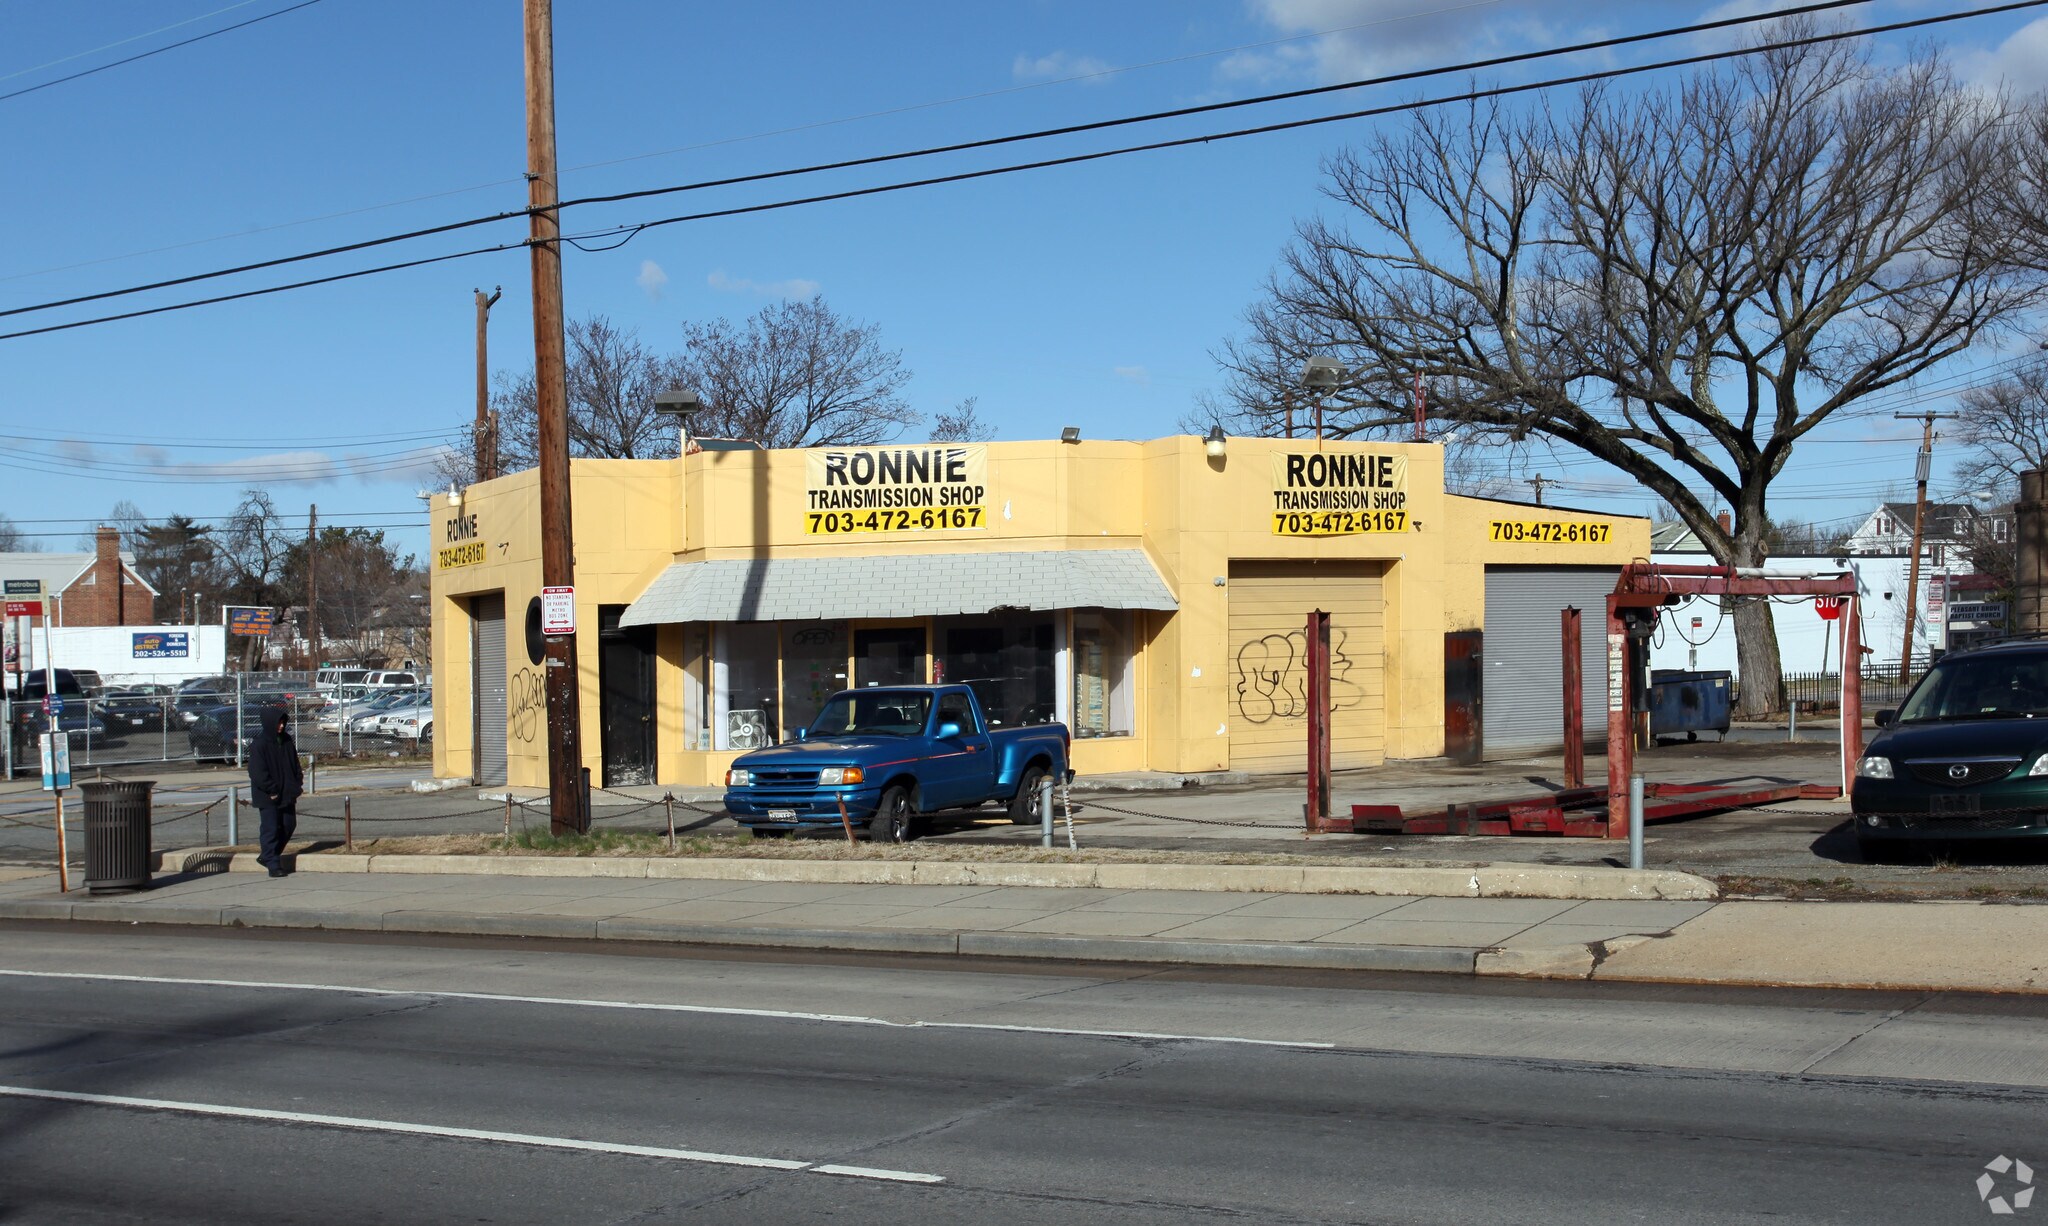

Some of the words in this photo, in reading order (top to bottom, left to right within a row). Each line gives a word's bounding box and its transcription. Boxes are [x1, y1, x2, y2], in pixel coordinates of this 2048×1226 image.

[826, 449, 966, 486] RONNIE
[1287, 454, 1393, 488] RONNIE
[808, 486, 933, 509] TRANSMISSION
[939, 485, 984, 506] SHOP
[1274, 490, 1369, 510] TRANSMISSION
[1373, 491, 1406, 510] SHOP
[447, 514, 477, 542] RONNIE
[809, 508, 981, 533] 703-472-6167
[1275, 511, 1406, 533] 703-472-6167
[1492, 522, 1609, 542] 703-472-6167
[440, 543, 484, 568] 703-472-6167
[1817, 596, 1838, 608] STO
[1950, 605, 1979, 613] PLEASANT
